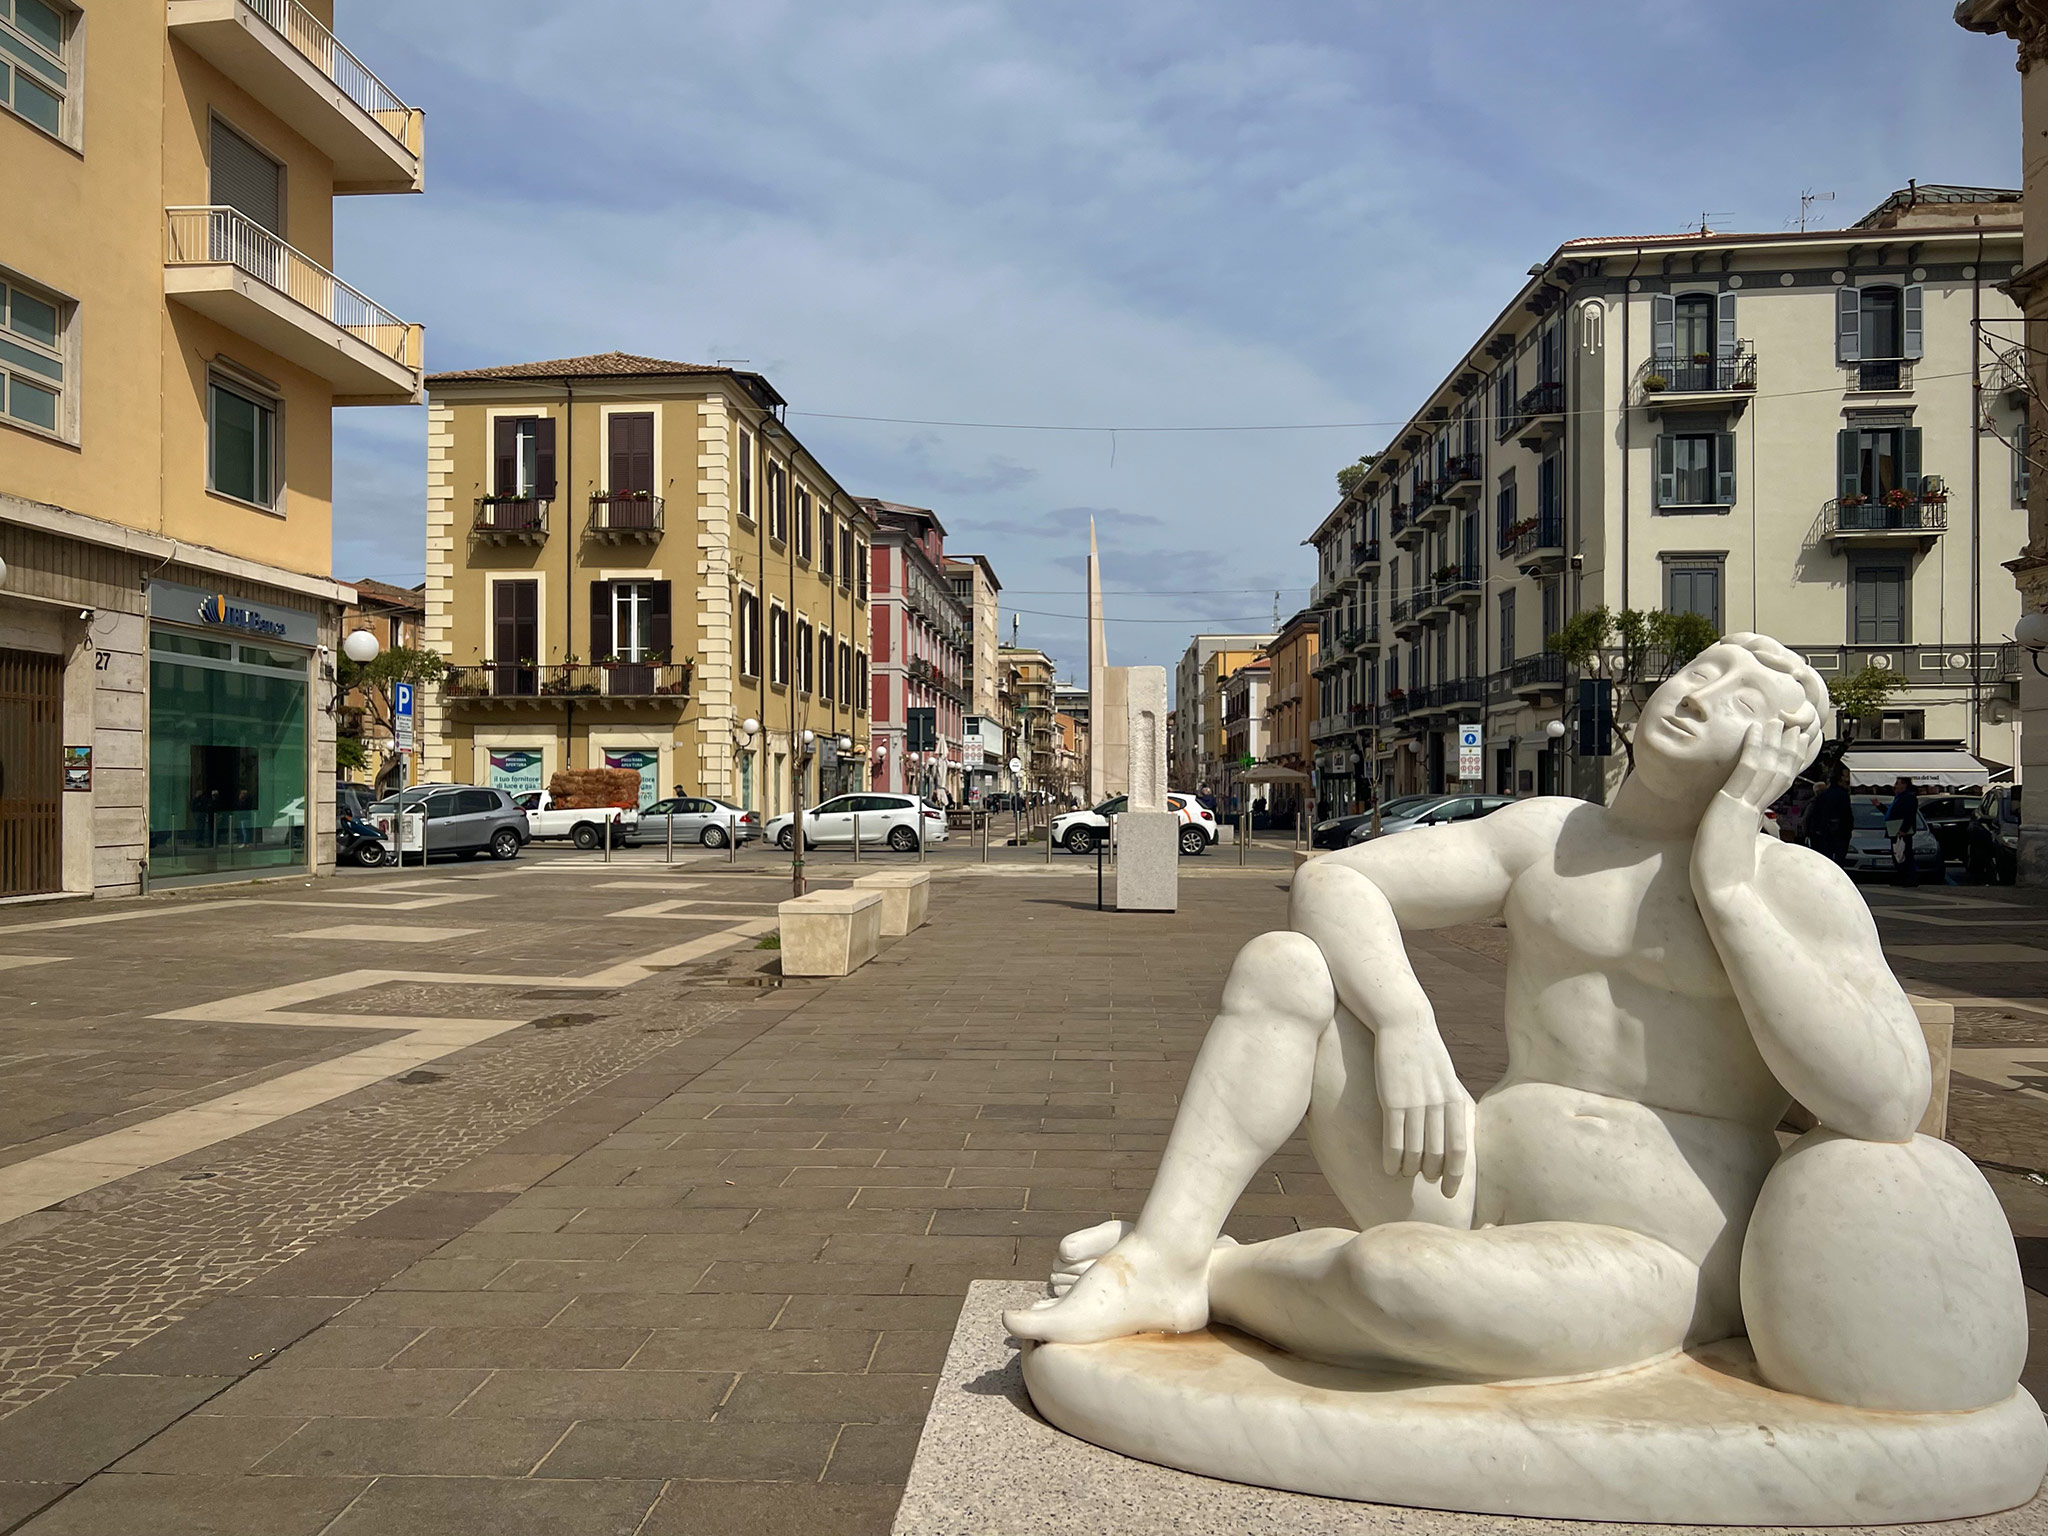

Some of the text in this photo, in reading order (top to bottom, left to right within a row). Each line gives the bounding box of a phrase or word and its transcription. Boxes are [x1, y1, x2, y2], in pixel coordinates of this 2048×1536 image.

[250, 611, 286, 635] Banca
[95, 652, 111, 671] 27
[398, 686, 410, 712] P
